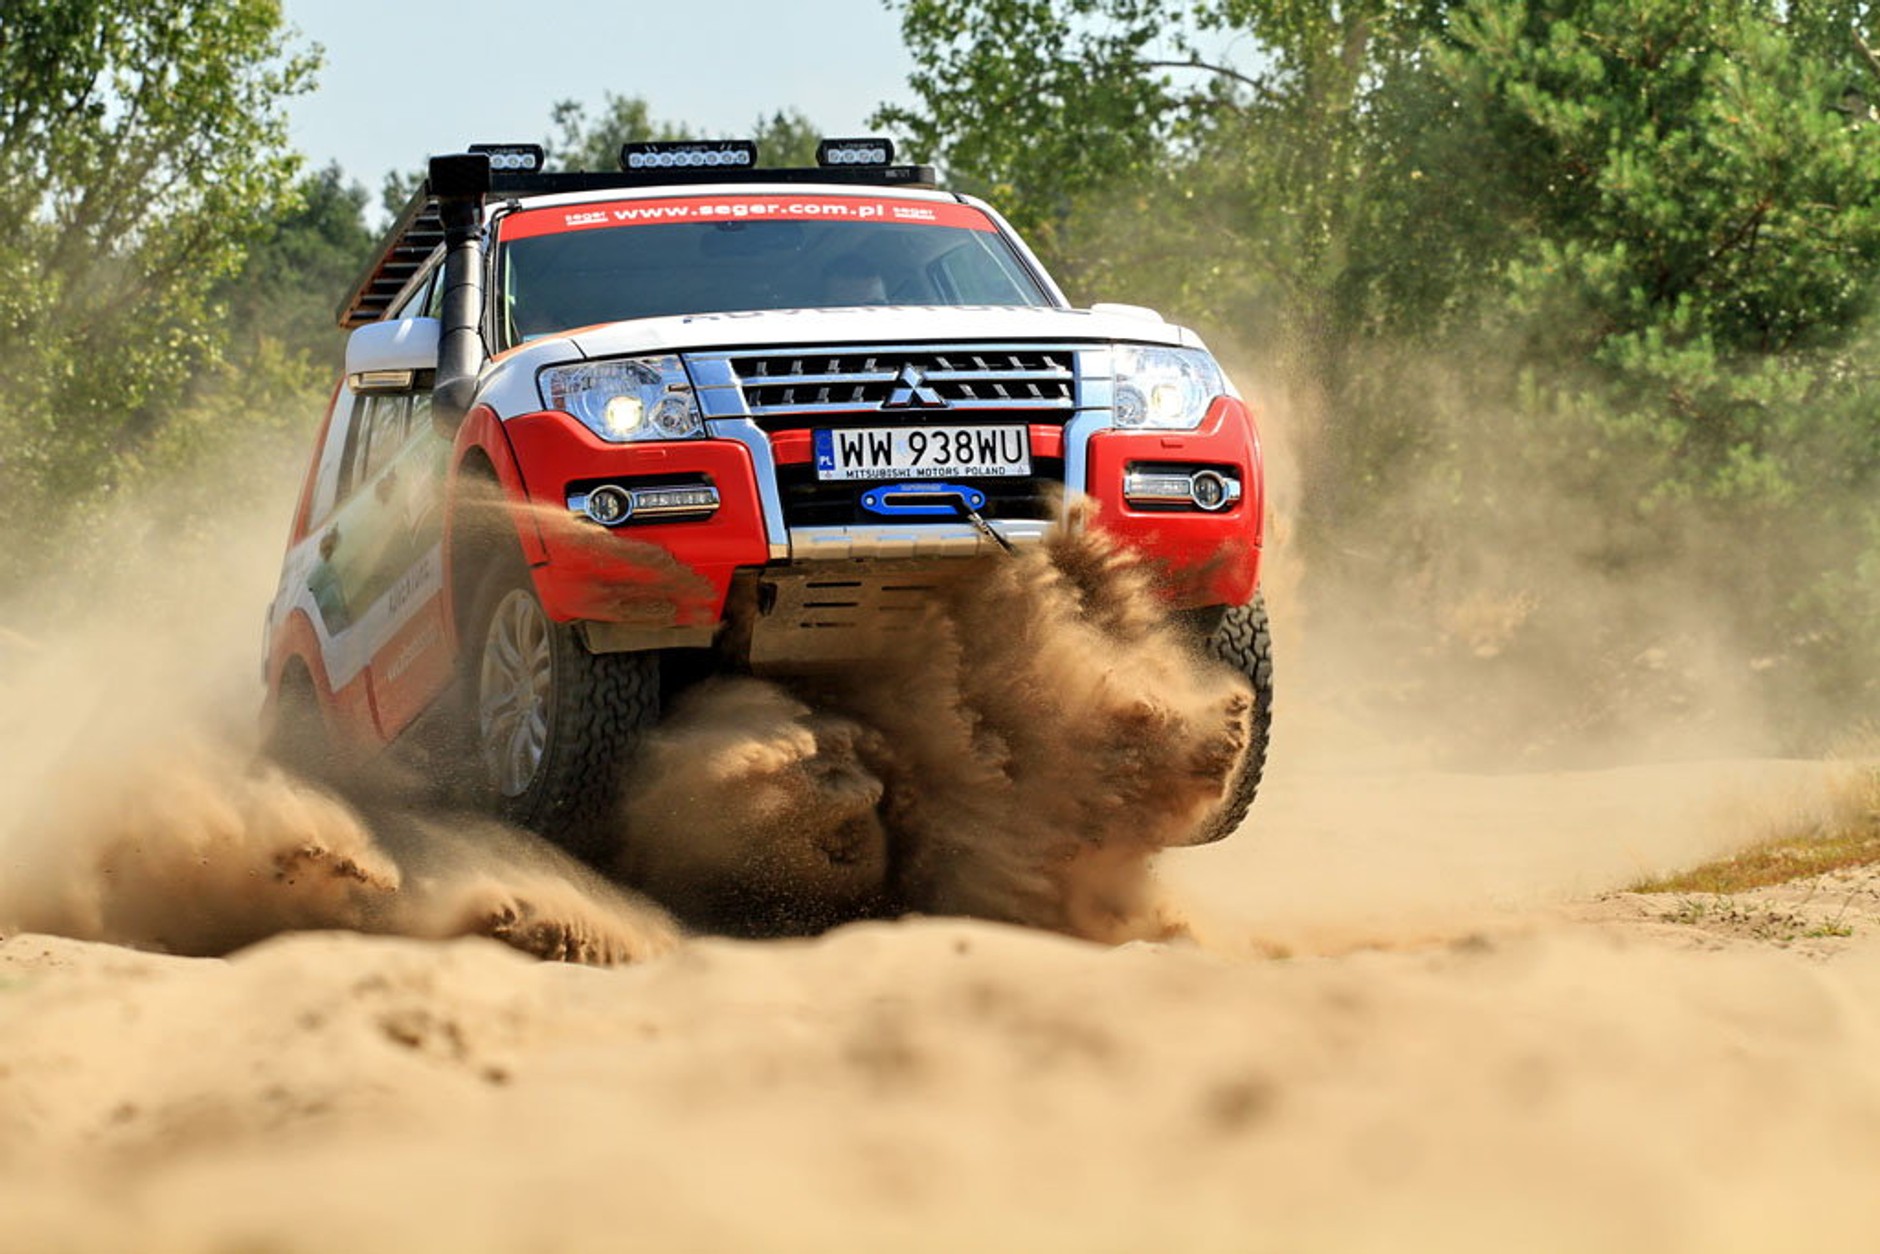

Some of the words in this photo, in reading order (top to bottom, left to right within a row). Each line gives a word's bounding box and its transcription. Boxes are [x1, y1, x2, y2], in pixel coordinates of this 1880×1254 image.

[614, 203, 884, 220] www.seger.com.pl
[839, 432, 892, 467] WW
[908, 430, 1023, 466] 938WU
[819, 456, 832, 466] PL
[846, 468, 911, 479] MITSUBISHI
[916, 467, 960, 477] MOTORS
[965, 466, 1006, 476] POLAND
